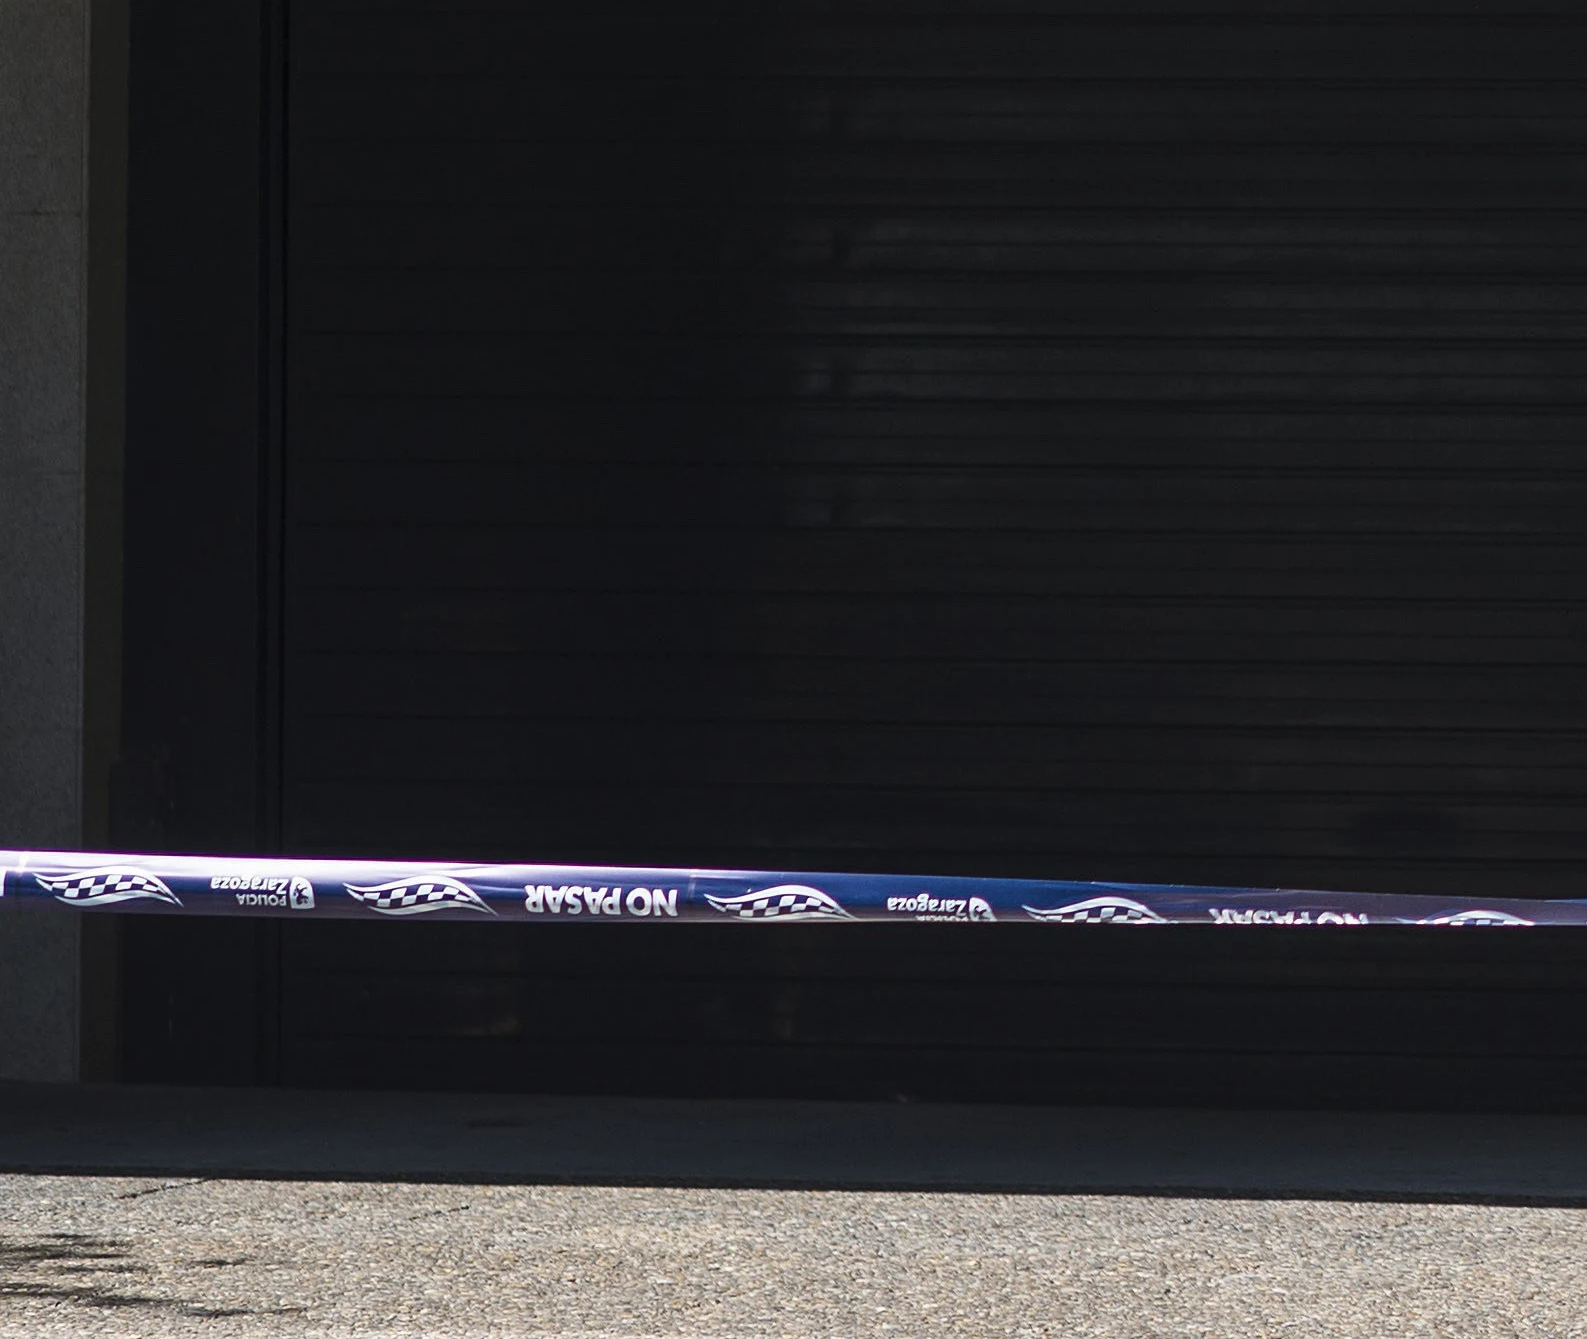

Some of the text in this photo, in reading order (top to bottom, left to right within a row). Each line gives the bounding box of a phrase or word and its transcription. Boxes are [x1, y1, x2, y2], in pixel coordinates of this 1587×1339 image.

[210, 875, 289, 895] Zaragoza
[236, 893, 287, 907] POLICIA
[524, 884, 679, 917] NO PASAR
[887, 893, 968, 916] Zaragoza
